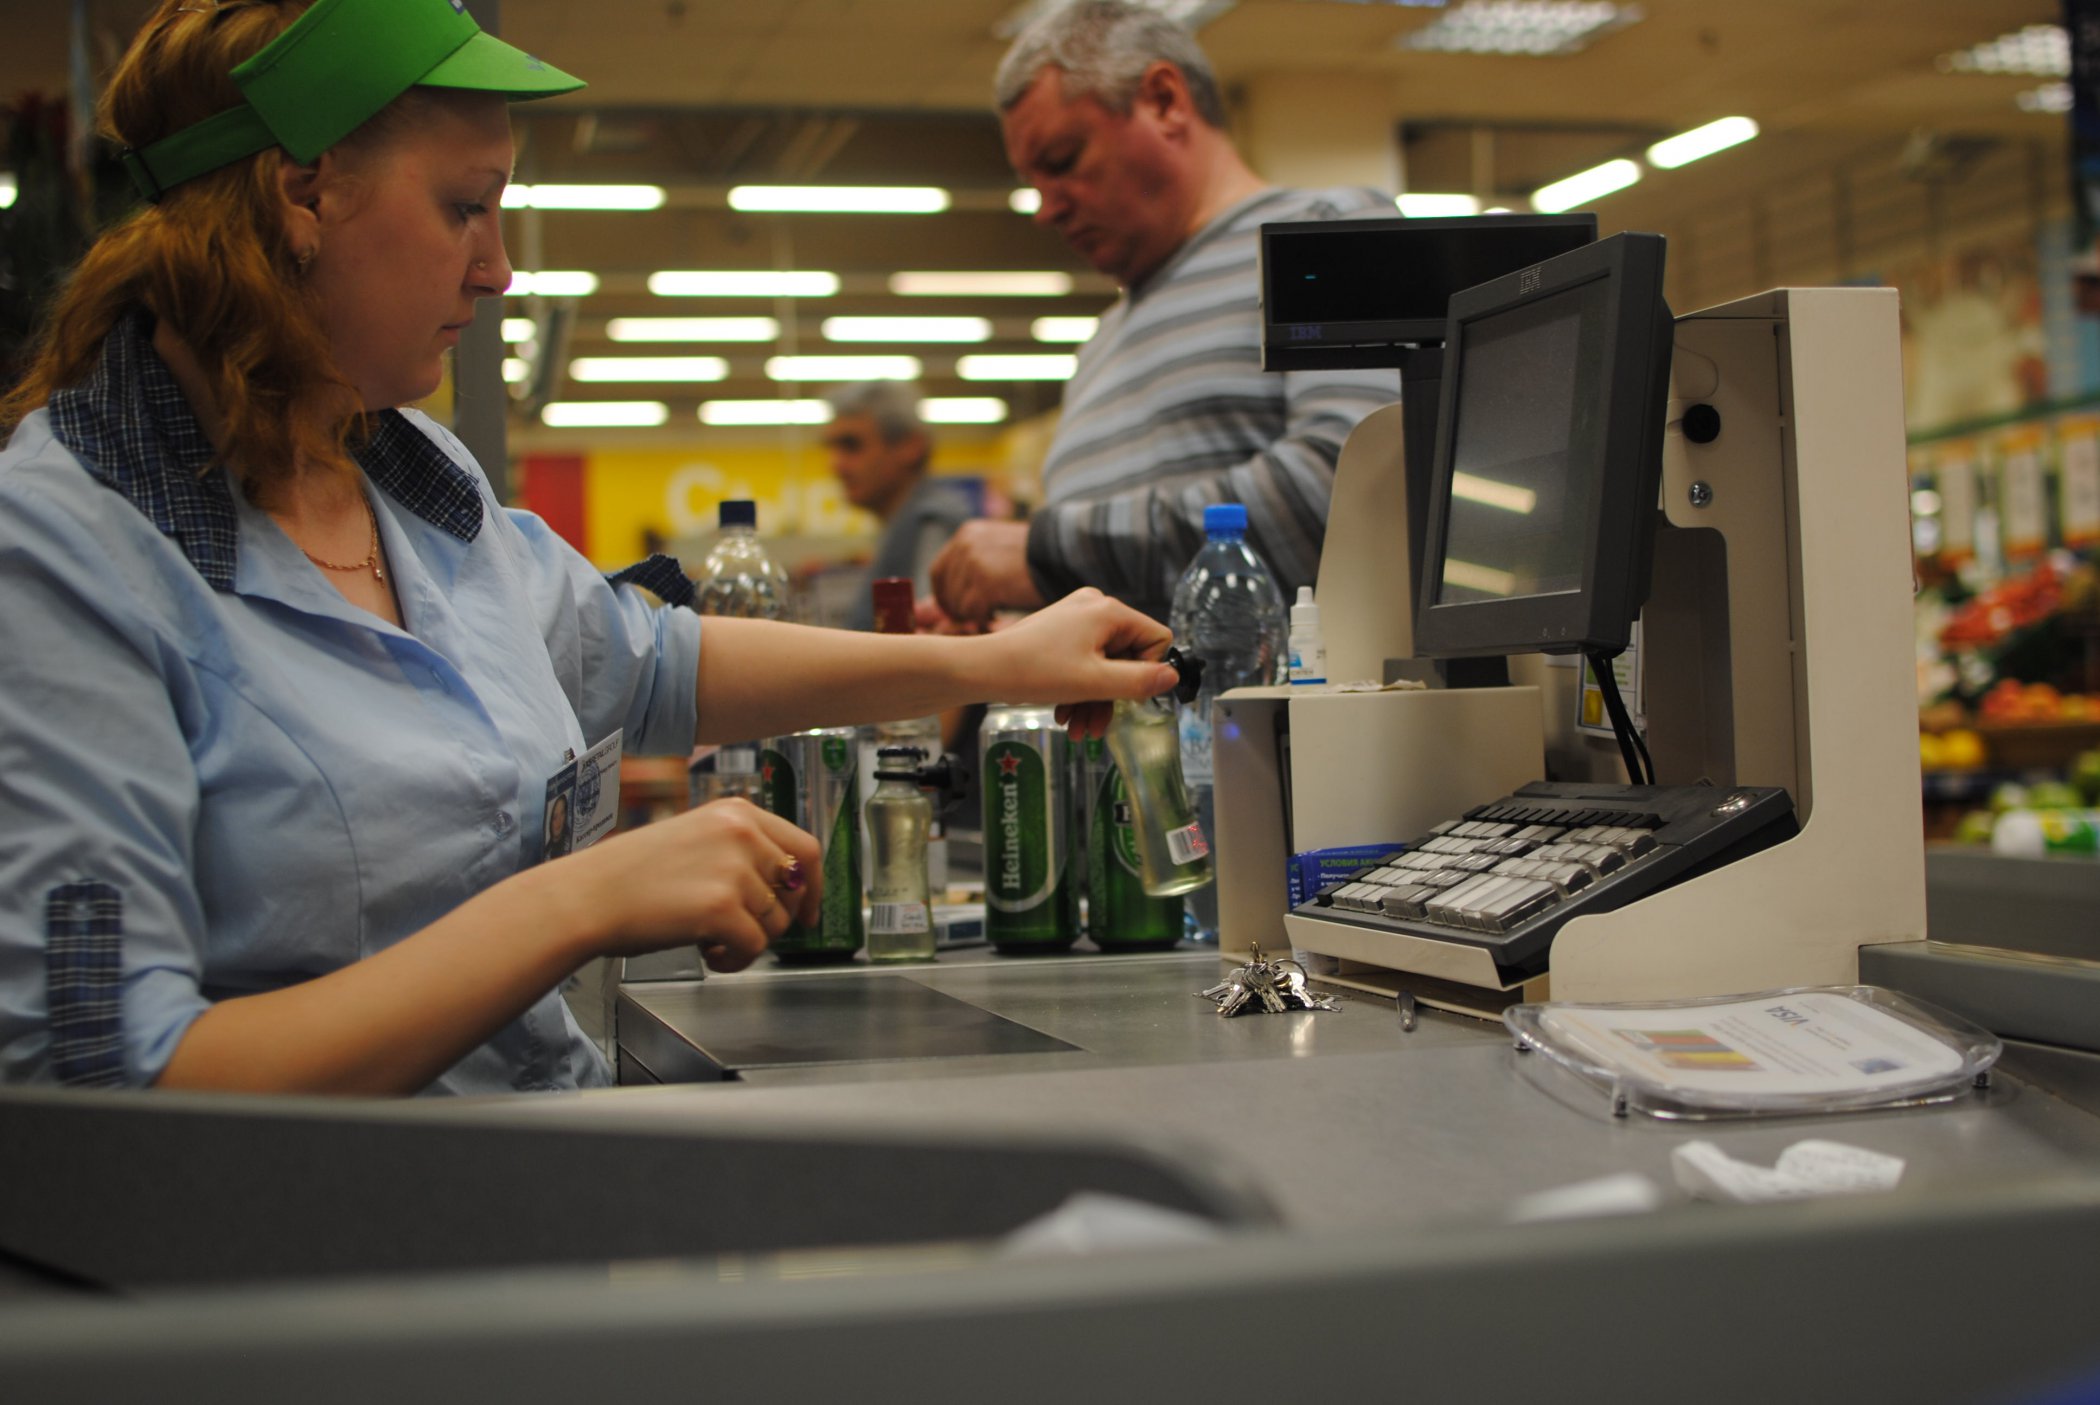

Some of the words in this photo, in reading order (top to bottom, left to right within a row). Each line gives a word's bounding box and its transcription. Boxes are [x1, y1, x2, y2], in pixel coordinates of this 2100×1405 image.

[1520, 265, 1543, 295] IBM
[1288, 325, 1322, 340] IBM
[999, 782, 1021, 890] Heineken
[1764, 1005, 1809, 1026] VISA
